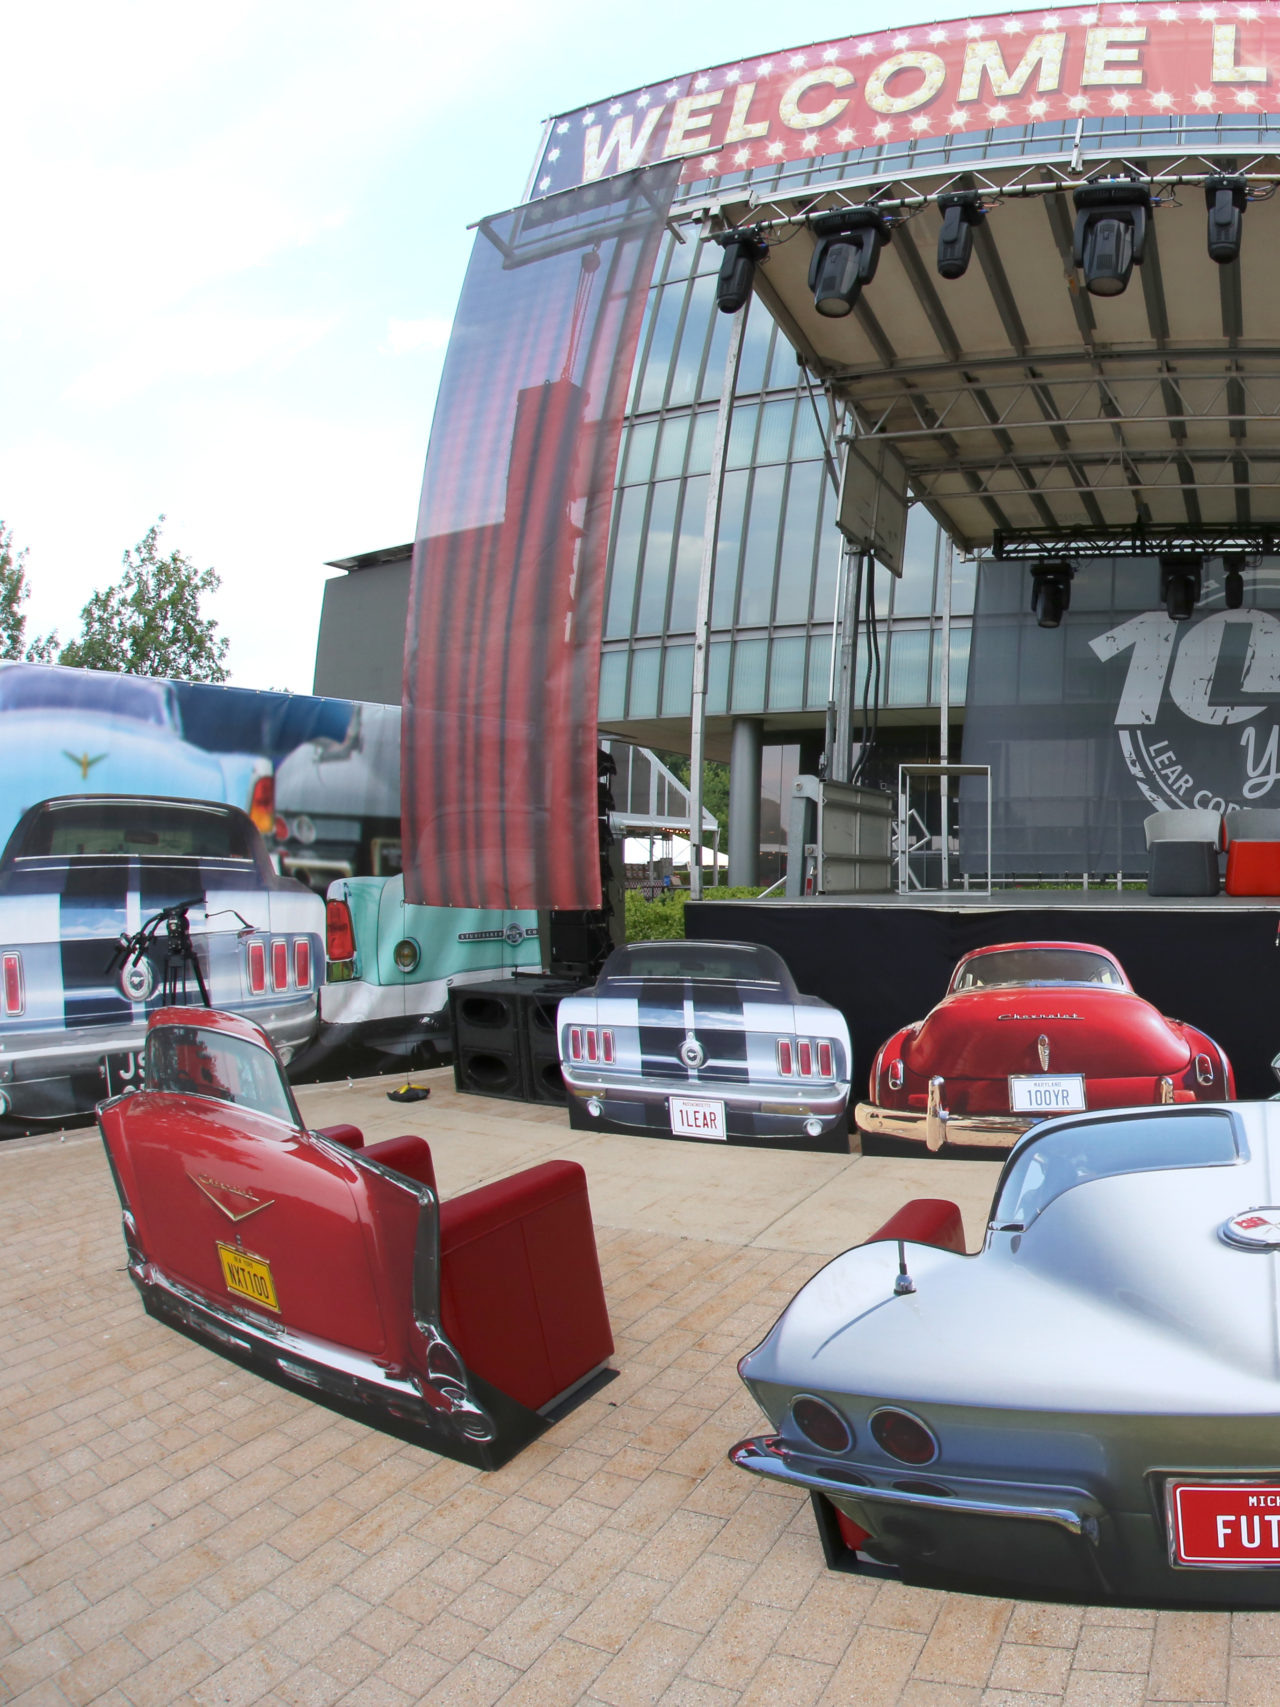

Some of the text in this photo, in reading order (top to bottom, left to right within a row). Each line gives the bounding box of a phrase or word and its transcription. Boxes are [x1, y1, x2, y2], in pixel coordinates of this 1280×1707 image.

[582, 25, 1148, 182] WELCOME
[1149, 740, 1194, 797] LEAR
[1027, 1089, 1070, 1106] 100YR
[679, 1109, 718, 1129] 1LEAR
[226, 1262, 270, 1300] NXT100
